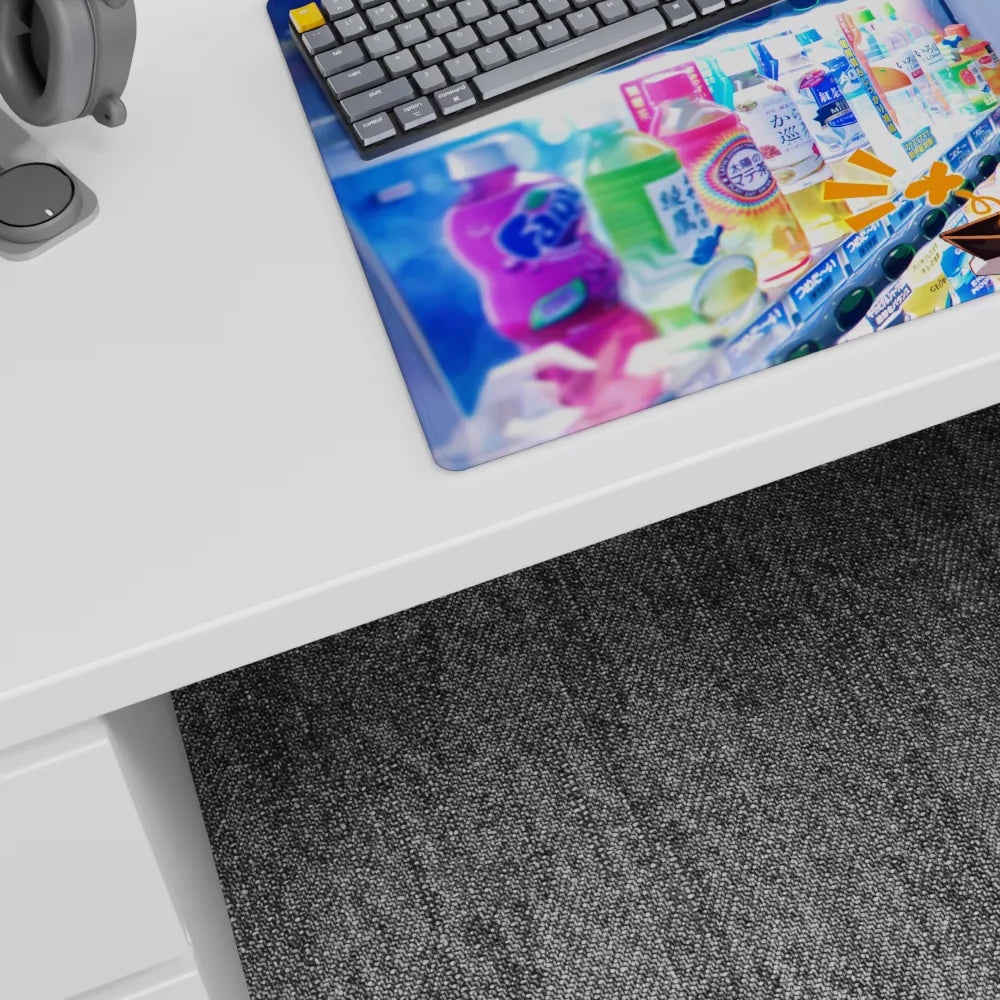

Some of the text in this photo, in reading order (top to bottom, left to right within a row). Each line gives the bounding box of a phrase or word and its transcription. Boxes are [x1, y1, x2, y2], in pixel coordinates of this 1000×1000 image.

[438, 85, 466, 99] command
[403, 101, 423, 113] option
[362, 116, 383, 129] control
[730, 153, 761, 174] 太陽の
[730, 161, 768, 187] マテ茶
